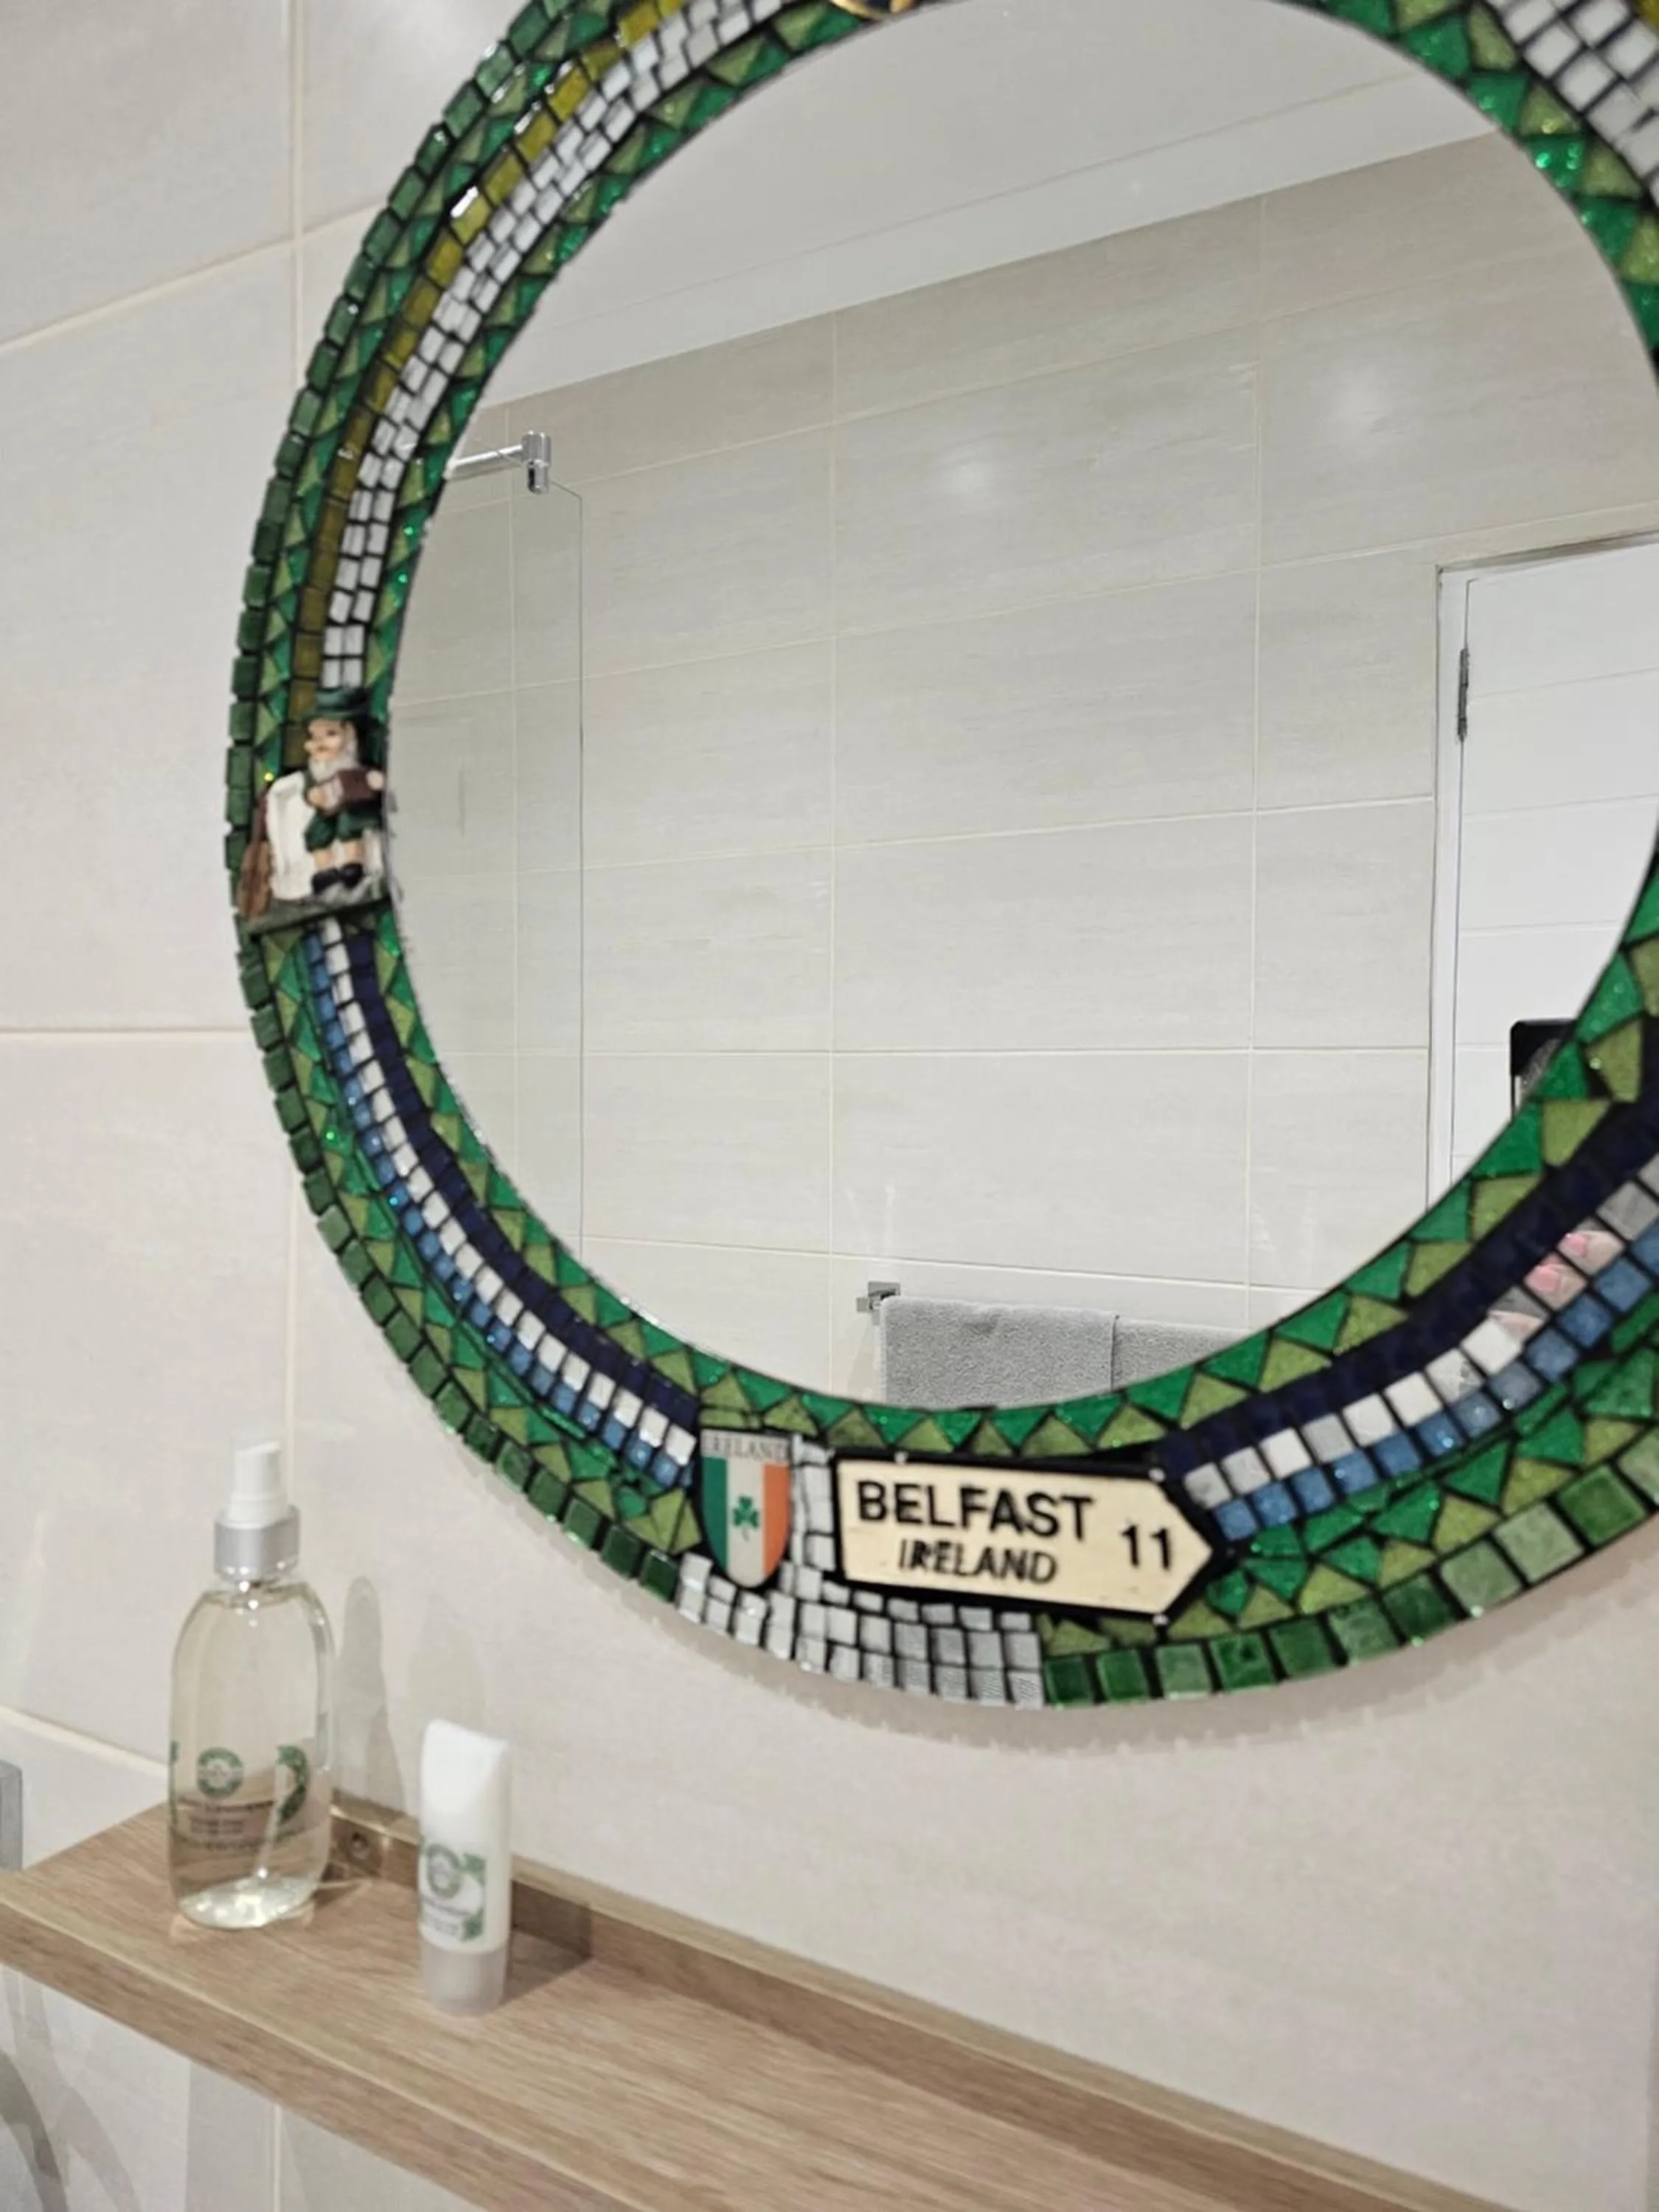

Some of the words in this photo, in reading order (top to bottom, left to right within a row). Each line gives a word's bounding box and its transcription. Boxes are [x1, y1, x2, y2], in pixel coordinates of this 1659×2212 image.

[857, 1481, 1093, 1541] BELFAST
[899, 1539, 1058, 1585] IRELAND
[1120, 1523, 1174, 1571] 11
